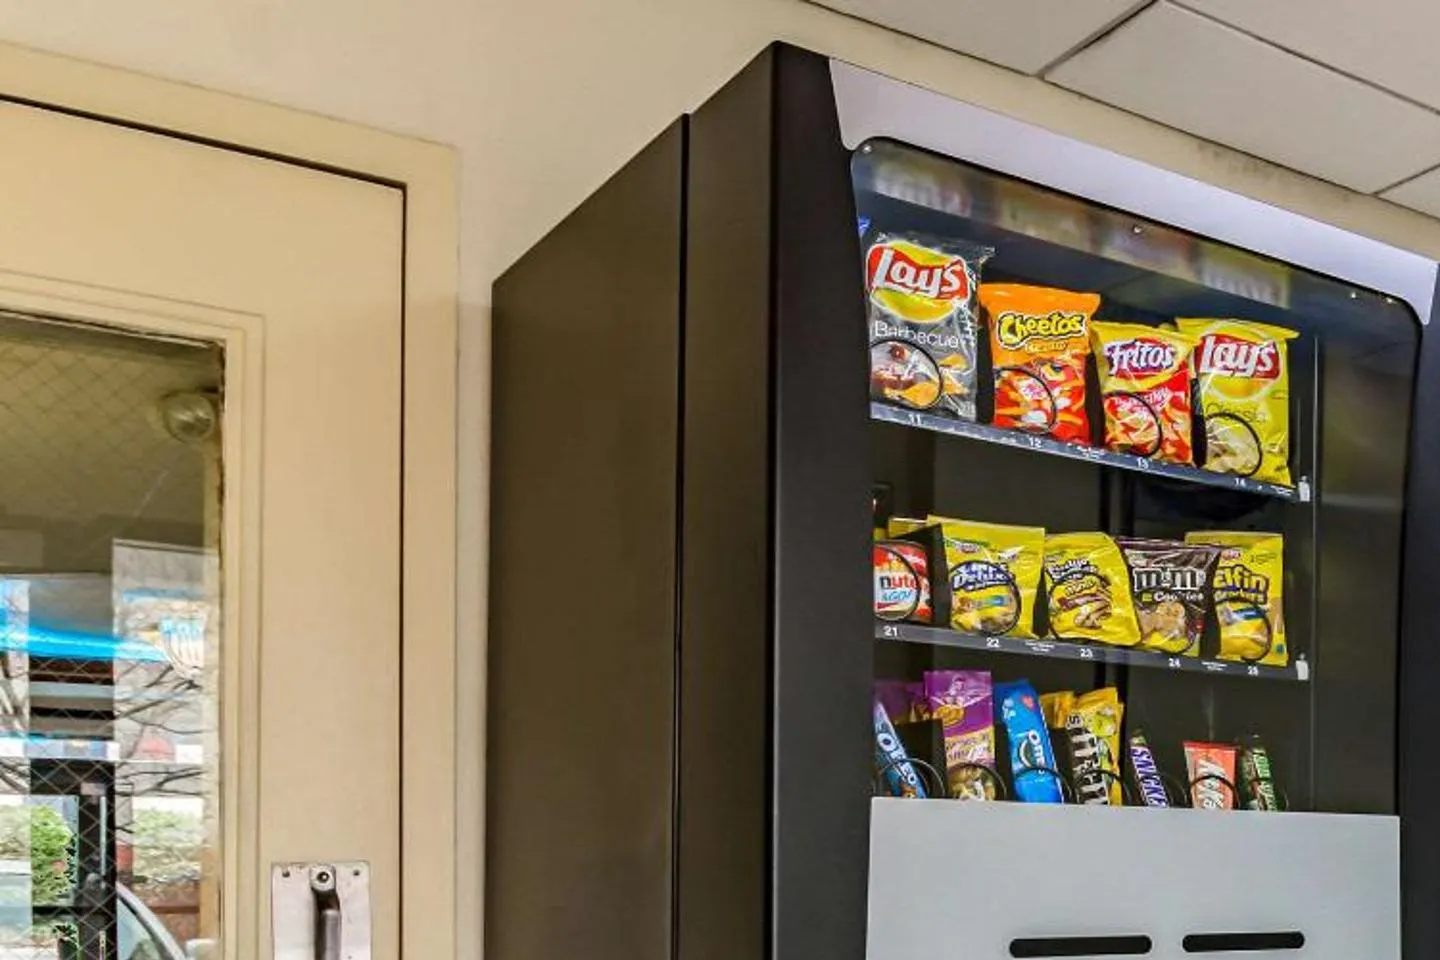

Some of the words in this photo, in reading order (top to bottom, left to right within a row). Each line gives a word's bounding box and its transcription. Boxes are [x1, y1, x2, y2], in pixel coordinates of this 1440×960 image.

[998, 311, 1086, 348] Cheetos
[1104, 341, 1175, 377] Fritos
[1028, 437, 1042, 449] 12
[883, 625, 898, 637] 21
[986, 637, 1000, 648] 22
